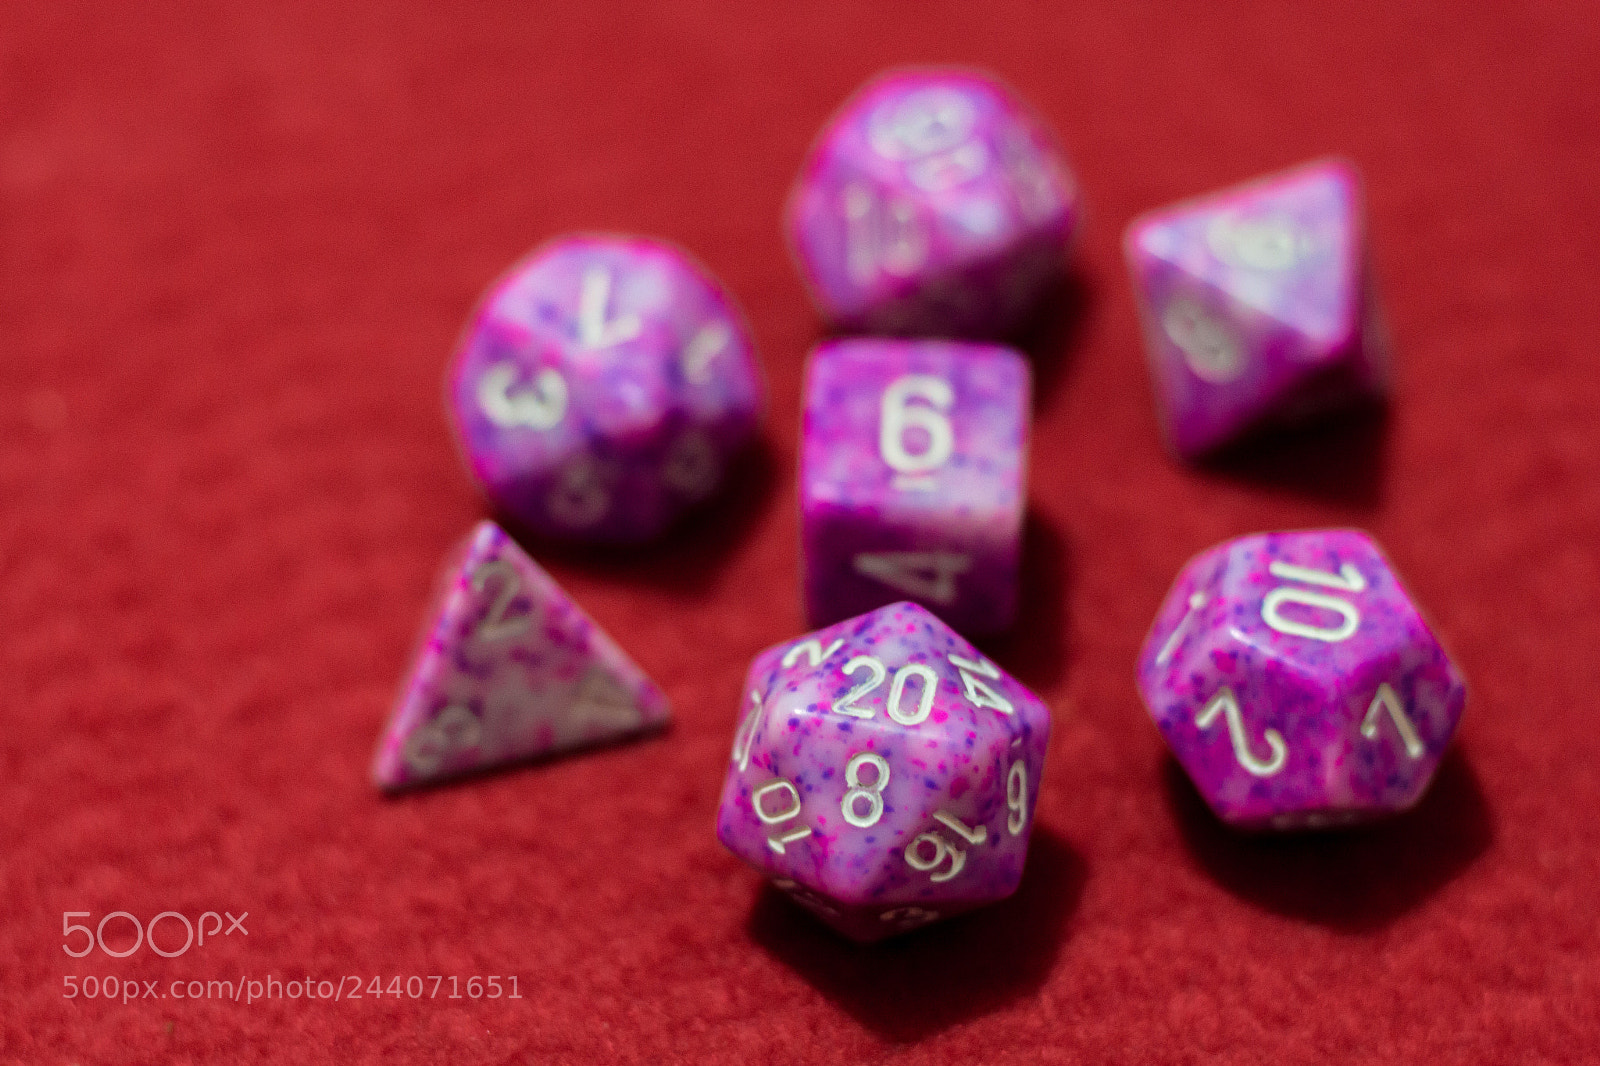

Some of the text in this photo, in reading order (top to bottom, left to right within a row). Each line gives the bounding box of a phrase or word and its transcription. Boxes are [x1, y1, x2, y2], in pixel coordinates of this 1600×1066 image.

[478, 362, 568, 430] 3
[881, 375, 954, 491] 6
[473, 560, 532, 642] 2
[853, 552, 970, 604] 4
[1261, 562, 1366, 643] 10
[782, 639, 845, 668] 2
[832, 655, 938, 725] 20
[948, 653, 1014, 714] 14
[1196, 688, 1288, 776] 2
[753, 781, 812, 855] 10
[841, 752, 890, 828] 8
[904, 810, 987, 882] 16
